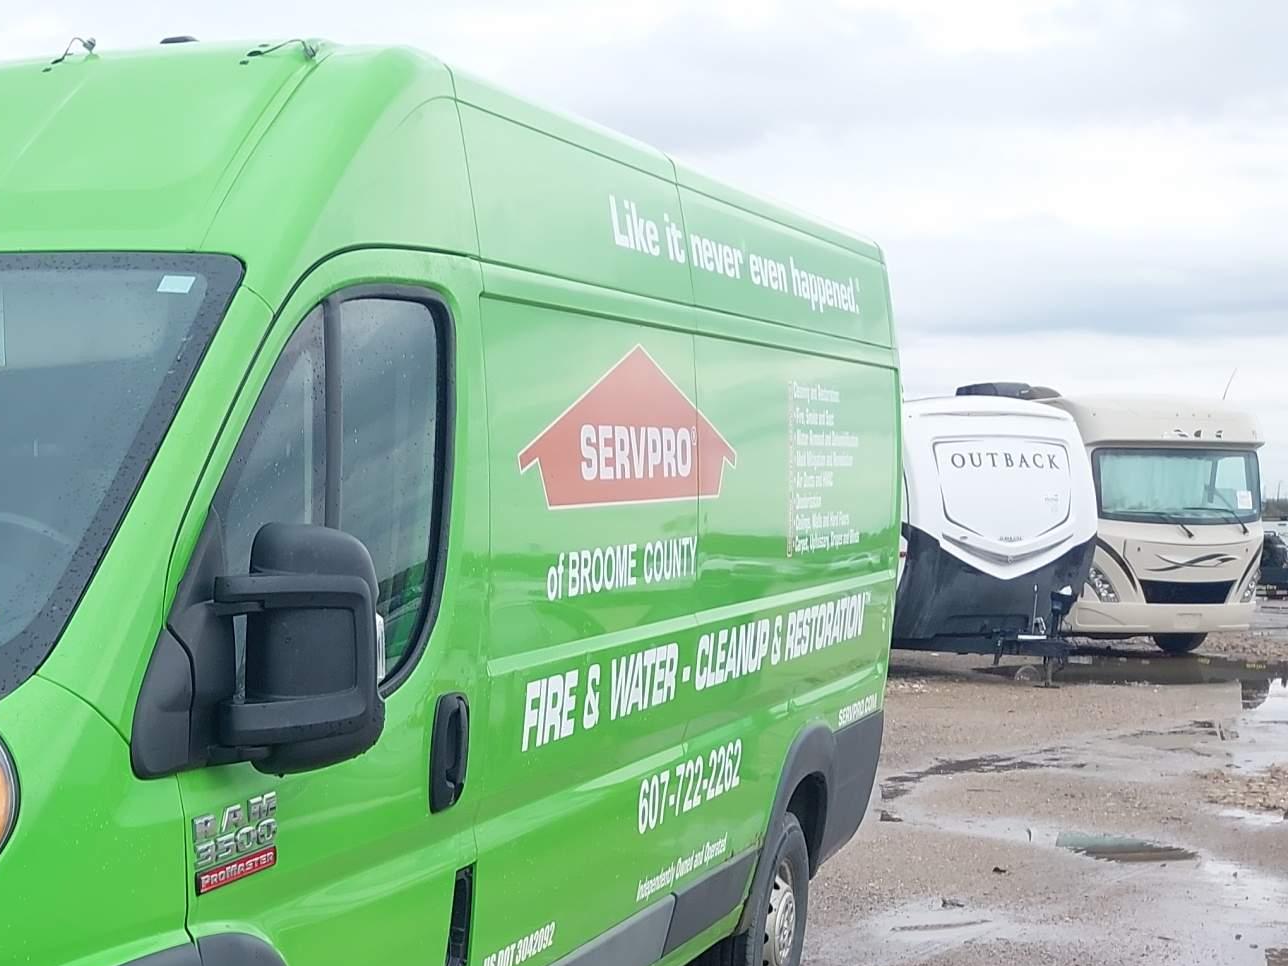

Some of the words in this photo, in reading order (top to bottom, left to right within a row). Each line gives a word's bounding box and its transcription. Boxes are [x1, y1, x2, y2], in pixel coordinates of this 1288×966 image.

[609, 194, 660, 257] Like
[663, 213, 686, 264] it
[690, 233, 743, 279] never
[749, 253, 788, 293] even
[950, 452, 1060, 471] OUTBACK
[547, 552, 565, 601] of
[568, 544, 637, 597] BROOME
[643, 536, 697, 584] COUNTY
[521, 669, 579, 752] FIRE
[583, 664, 601, 730] &
[610, 643, 679, 720] WATER
[695, 618, 770, 691] CLEANUP
[771, 619, 783, 666] &
[638, 739, 743, 834] 607-722-2262
[194, 818, 278, 867] 3500
[636, 862, 675, 903] Independently
[675, 850, 694, 881] Owned
[693, 843, 705, 870] and
[704, 831, 728, 867] Operated
[515, 921, 556, 966] 3042092
